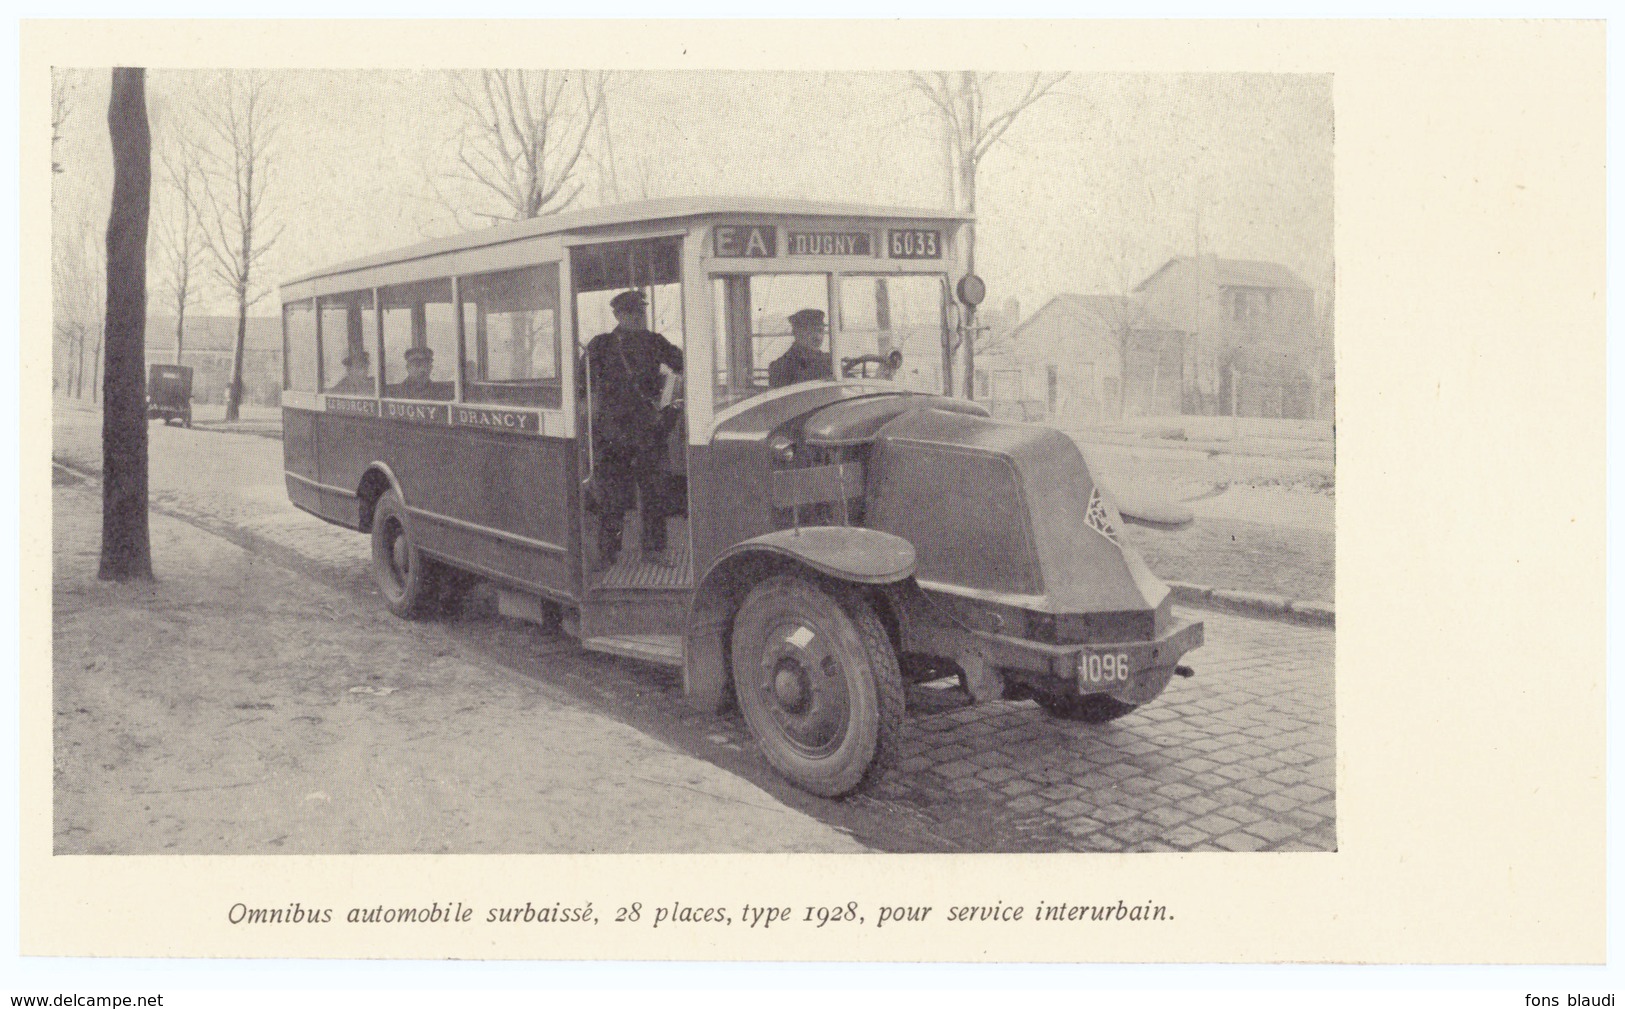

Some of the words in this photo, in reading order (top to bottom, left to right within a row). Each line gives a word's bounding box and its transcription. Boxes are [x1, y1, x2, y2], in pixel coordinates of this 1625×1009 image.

[796, 234, 859, 254] DUGNY
[892, 231, 936, 256] 6033
[388, 403, 436, 419] DUGNY
[459, 409, 527, 428] DRANCY
[1081, 652, 1129, 682] 1096
